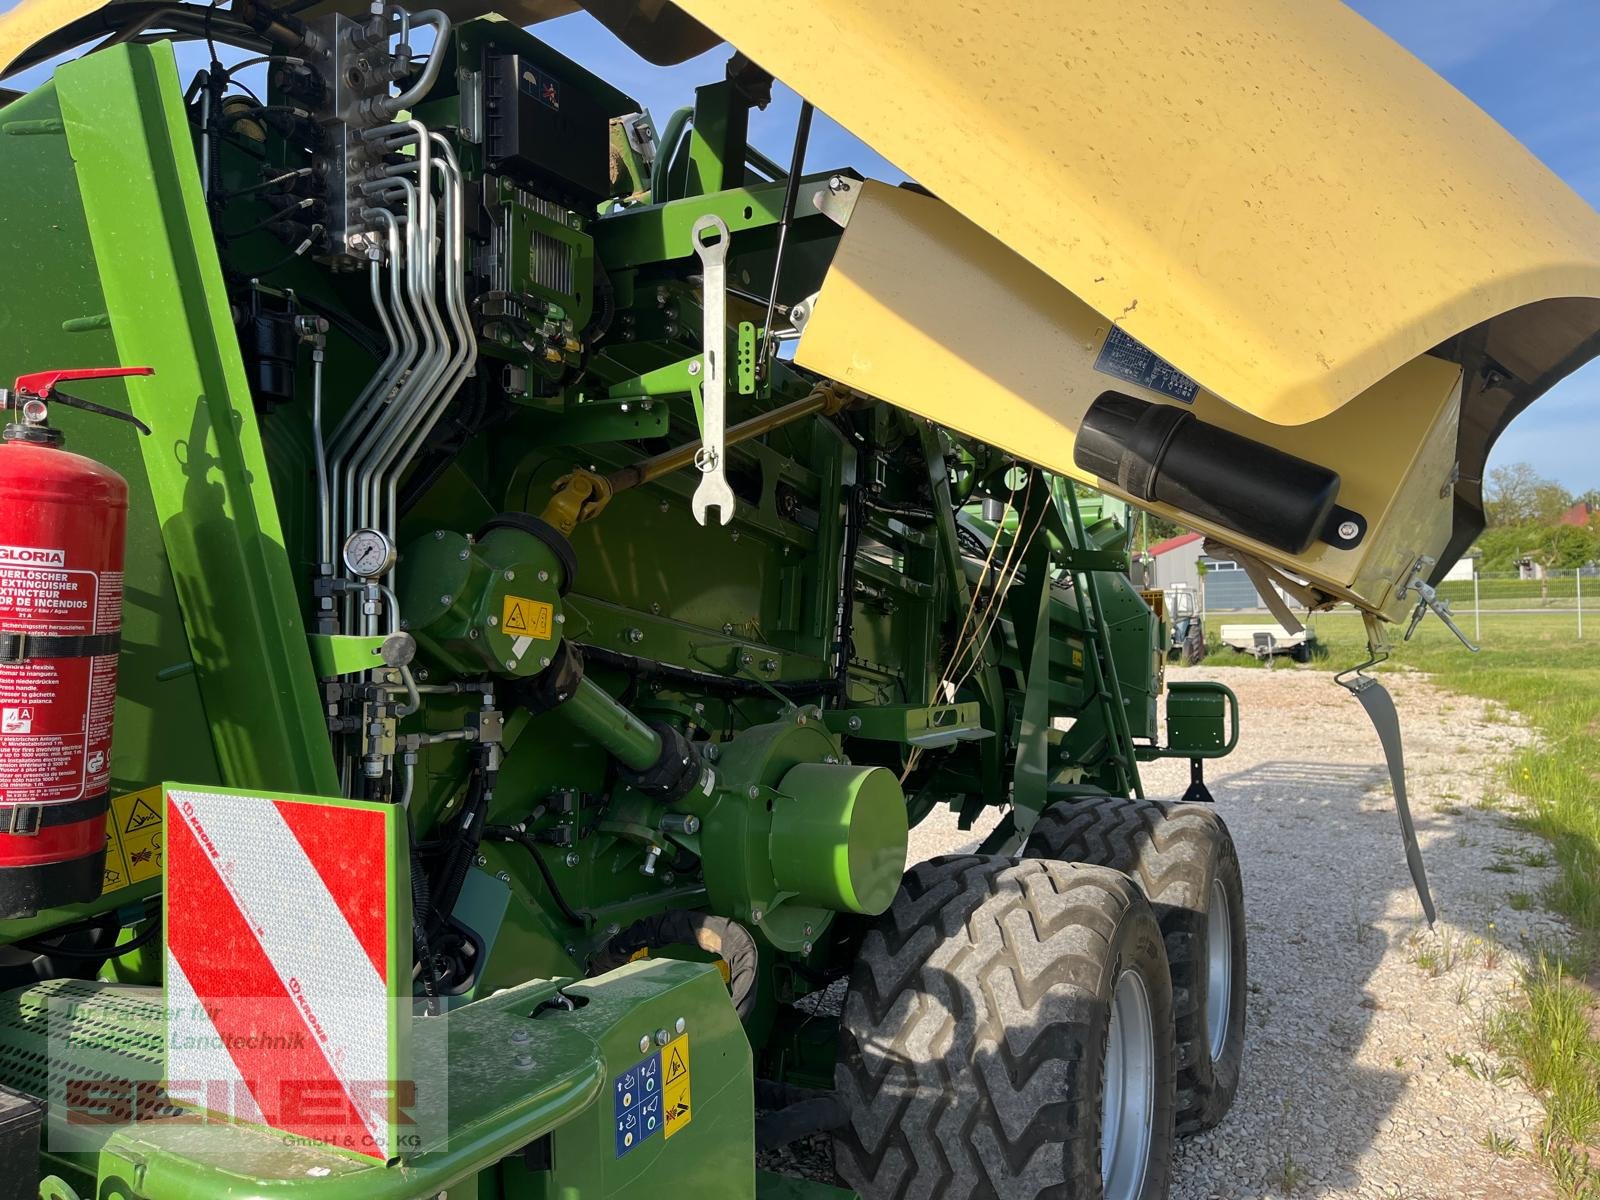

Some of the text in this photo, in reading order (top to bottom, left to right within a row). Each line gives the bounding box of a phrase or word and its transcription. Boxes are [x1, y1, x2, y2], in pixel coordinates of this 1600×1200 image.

[0, 549, 63, 564] GLORIA
[2, 579, 78, 591] EXTINGUISHER
[17, 597, 31, 606] DE
[35, 599, 88, 608] INCENDIOS
[22, 709, 30, 718] A
[190, 817, 219, 859] KRONE
[297, 994, 328, 1044] KRONE
